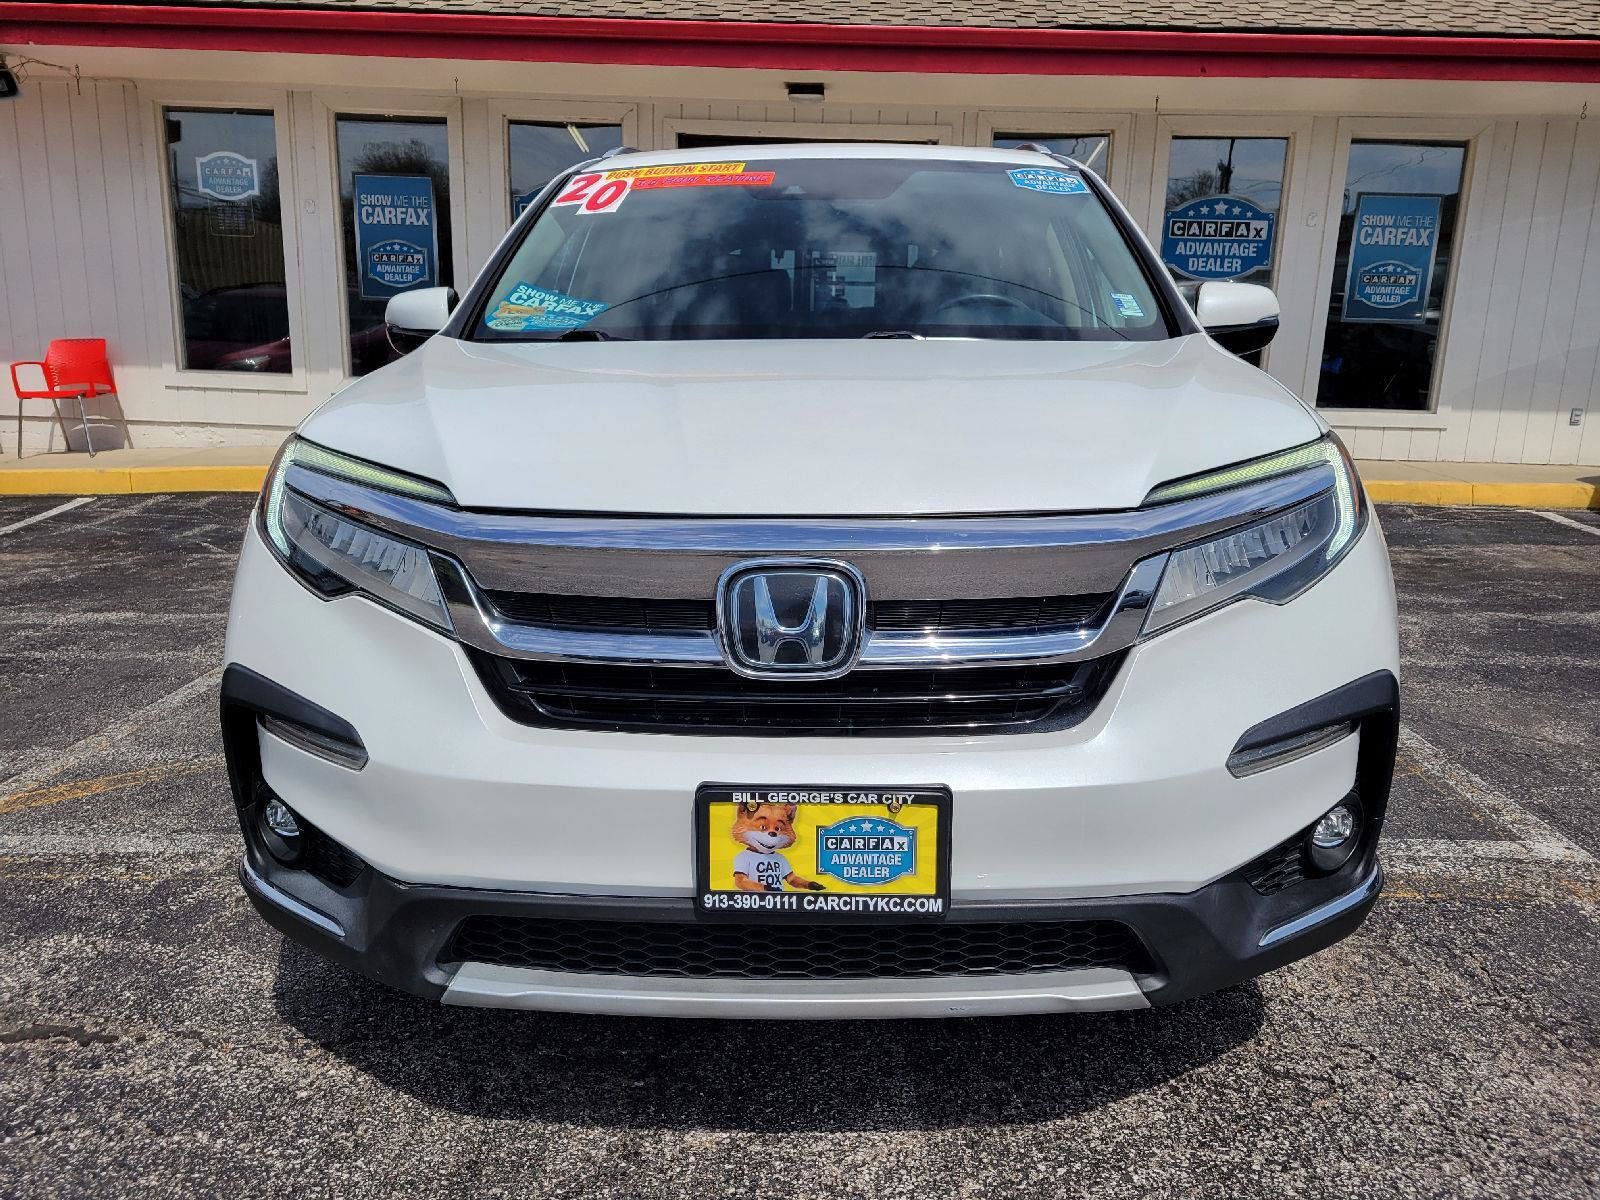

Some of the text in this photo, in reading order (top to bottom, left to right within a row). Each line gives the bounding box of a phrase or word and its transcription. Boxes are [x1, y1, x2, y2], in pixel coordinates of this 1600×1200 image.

[606, 163, 740, 180] PUSH BUTTON START
[208, 177, 249, 186] ADVANTAGE
[216, 185, 242, 193] DEALER
[555, 174, 629, 212] 20
[360, 194, 429, 208] SHOW ME THE
[361, 206, 430, 226] CARFAX
[1362, 214, 1434, 228] SHOW ME THE
[1172, 221, 1267, 239] CARFAX
[1360, 226, 1431, 246] CARFAX
[1175, 242, 1257, 257] ADVANTAGE
[372, 253, 424, 264] CARFAX
[1188, 258, 1242, 272] DEALER
[376, 264, 420, 274] ADVANTAGE
[384, 273, 413, 282] DEALER
[1363, 275, 1415, 285] CARFAX
[516, 285, 559, 302] SHOW
[559, 297, 578, 307] ME
[1364, 285, 1411, 295] ADVANTAGE
[509, 292, 601, 316] CARFAX
[1371, 294, 1401, 303] DEALER
[732, 792, 915, 806] BILL GEORGE'S CAR CITY
[825, 836, 909, 851] CARFAX
[830, 853, 902, 866] ADVANTAGE
[755, 861, 782, 874] CAR
[843, 866, 890, 878] DEALER
[757, 874, 784, 886] FOX
[703, 893, 943, 913] 913-390-0111 CARCITYKC.COM
